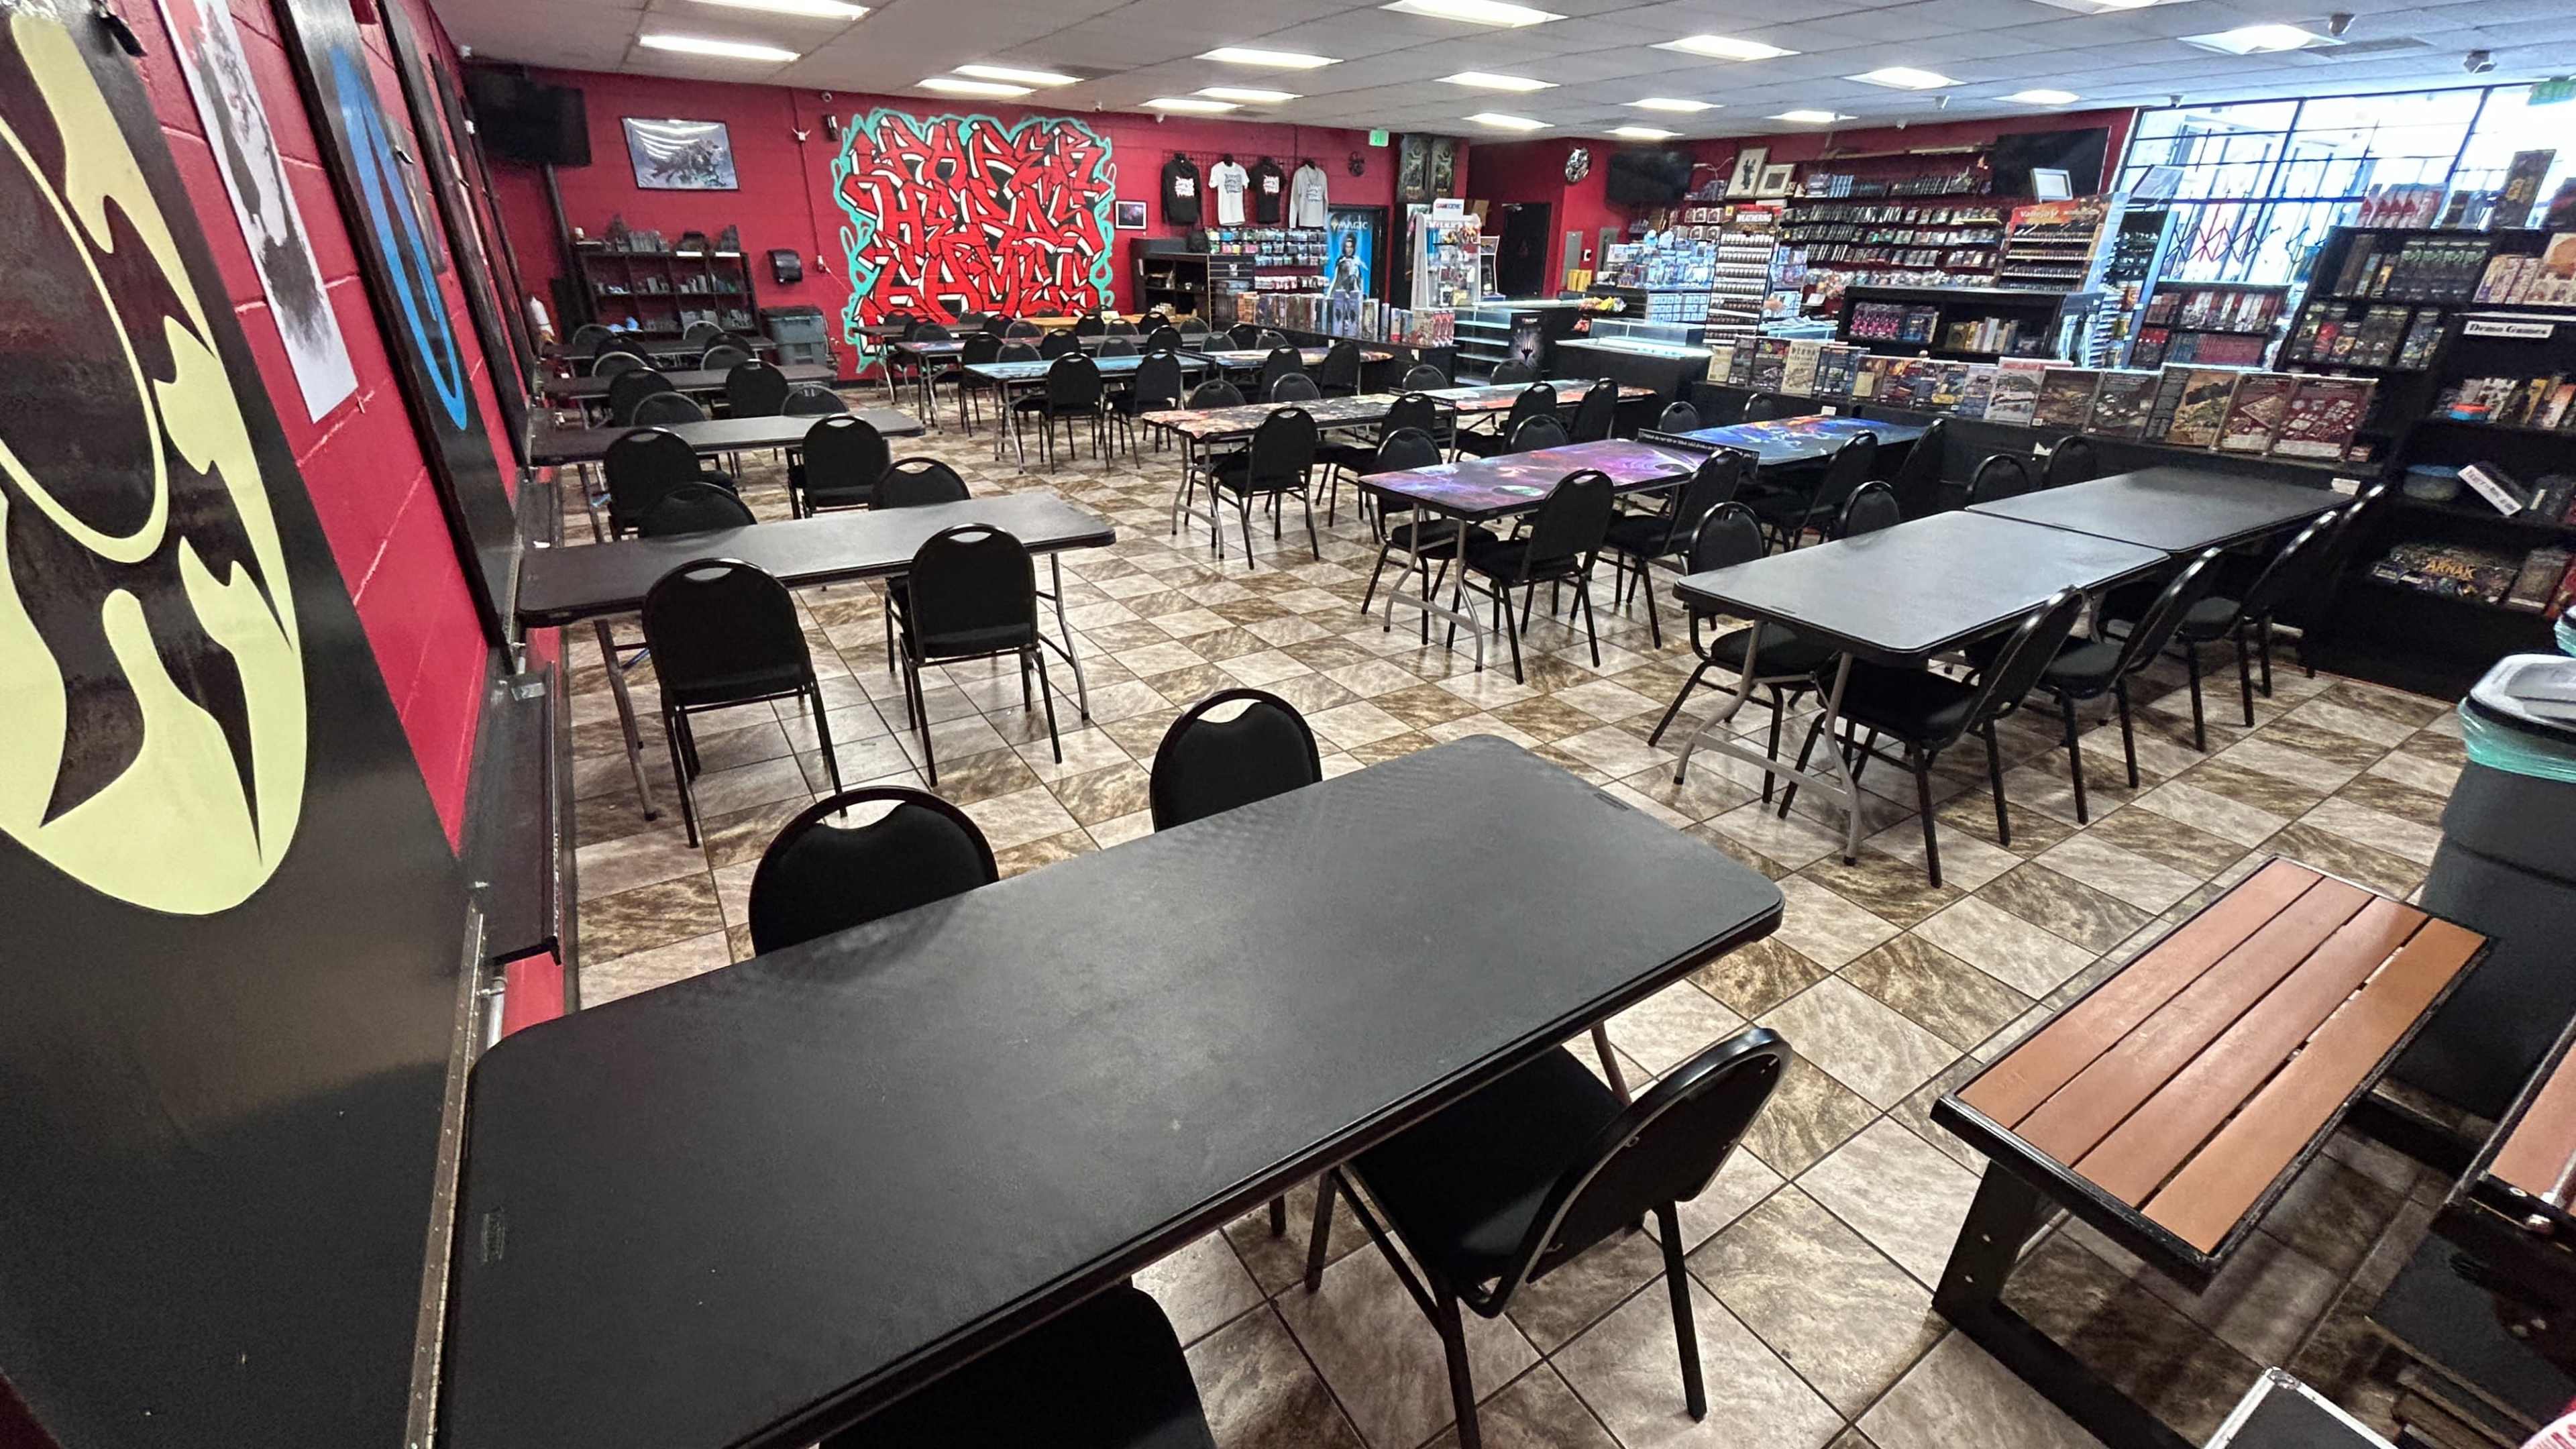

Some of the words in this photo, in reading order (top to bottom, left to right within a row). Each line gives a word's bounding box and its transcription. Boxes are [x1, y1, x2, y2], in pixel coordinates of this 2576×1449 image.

[1338, 215, 1368, 229] MAGIC
[2469, 323, 2503, 332] Demo
[2506, 325, 2548, 335] Games
[2425, 558, 2477, 581] ARNAK
